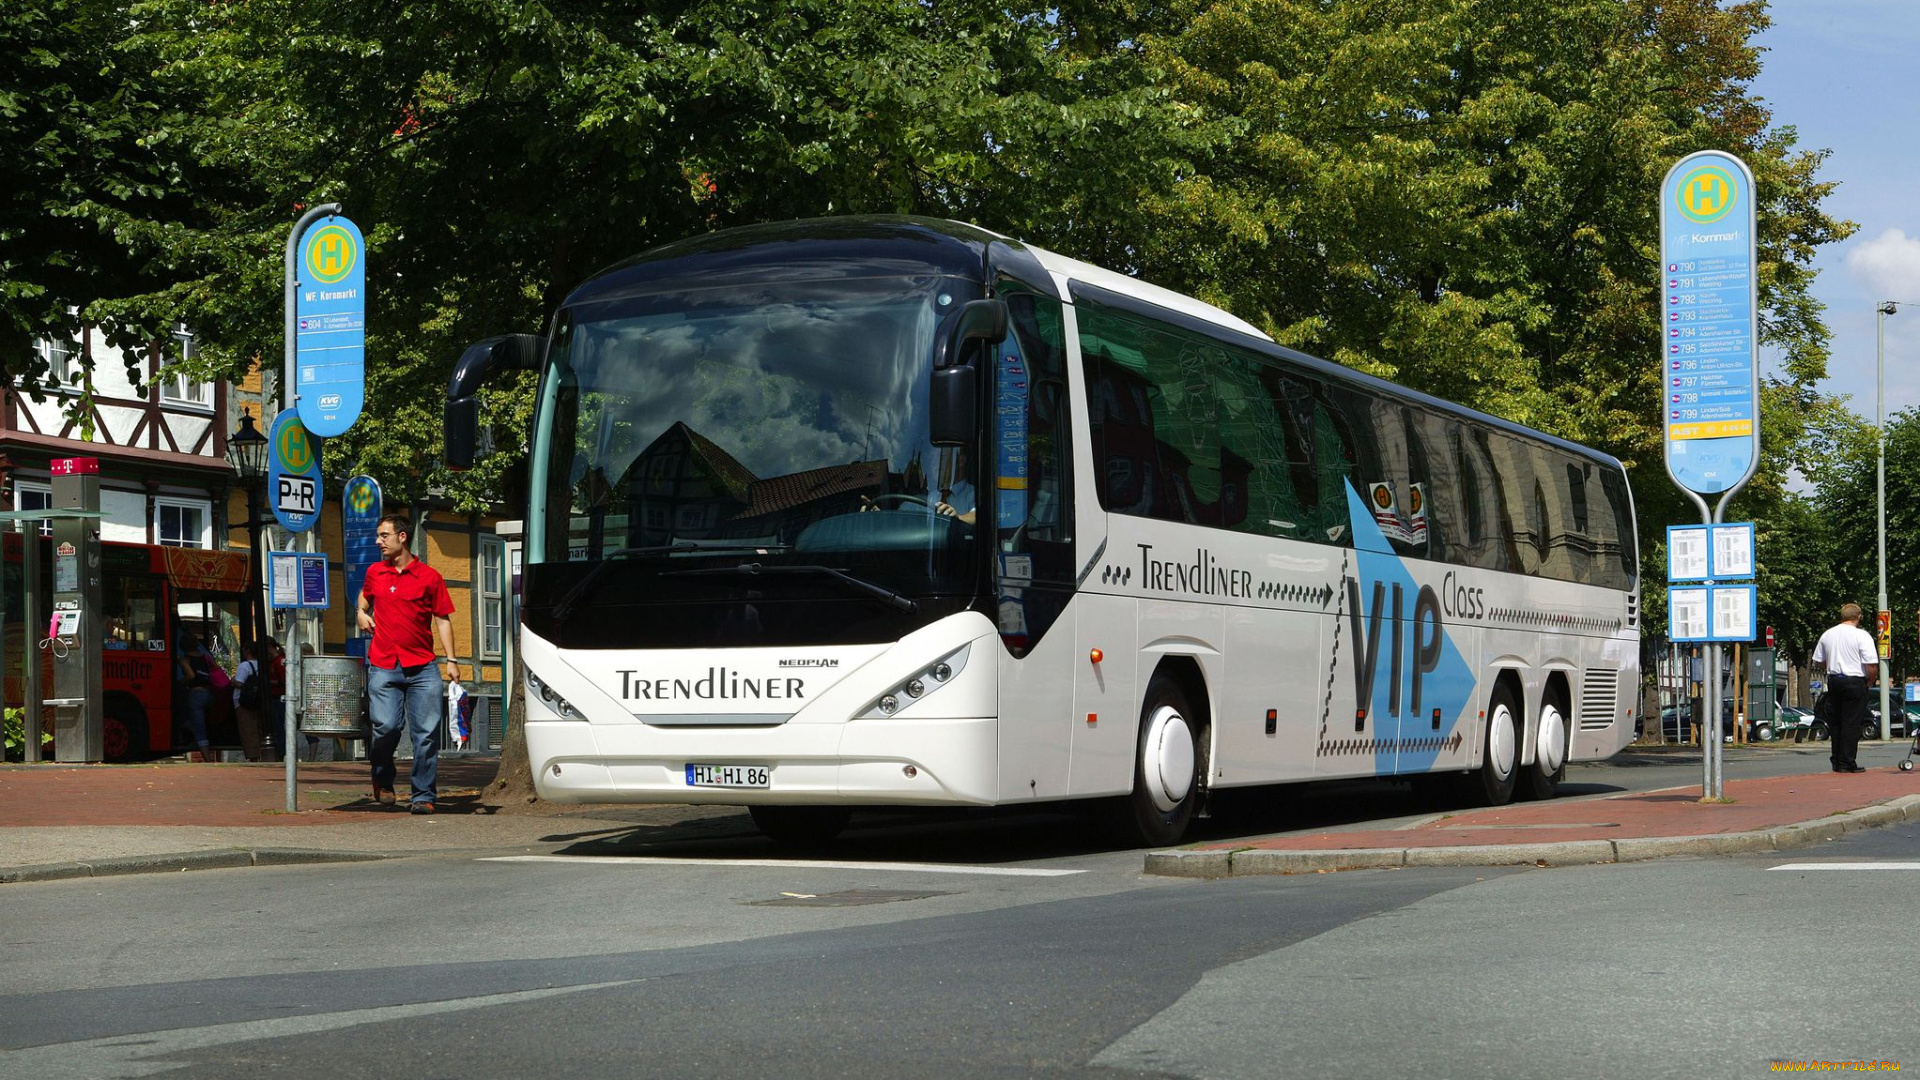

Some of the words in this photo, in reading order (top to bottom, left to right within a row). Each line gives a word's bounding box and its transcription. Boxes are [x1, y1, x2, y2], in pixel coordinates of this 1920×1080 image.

[1692, 178, 1720, 210] H
[320, 239, 342, 270] H
[1679, 261, 1695, 272] 790
[1679, 278, 1694, 288] 791
[320, 289, 356, 301] Kornmarkt
[1680, 295, 1695, 304] 792
[1680, 311, 1696, 321] 793
[308, 320, 321, 330] 604
[1680, 328, 1695, 337] 794
[1681, 343, 1696, 354] 795
[1681, 360, 1697, 370] 796
[1682, 377, 1698, 387] 797
[320, 396, 339, 404] KVG
[1682, 393, 1698, 403] 798
[1682, 409, 1698, 419] 799
[287, 431, 306, 462] H
[63, 459, 73, 473] T
[1347, 576, 1443, 720] VIP
[1443, 571, 1484, 619] Class
[778, 658, 839, 667] NEOPLAN
[695, 766, 713, 783] HI
[724, 768, 743, 784] HI
[747, 768, 768, 785] 86
